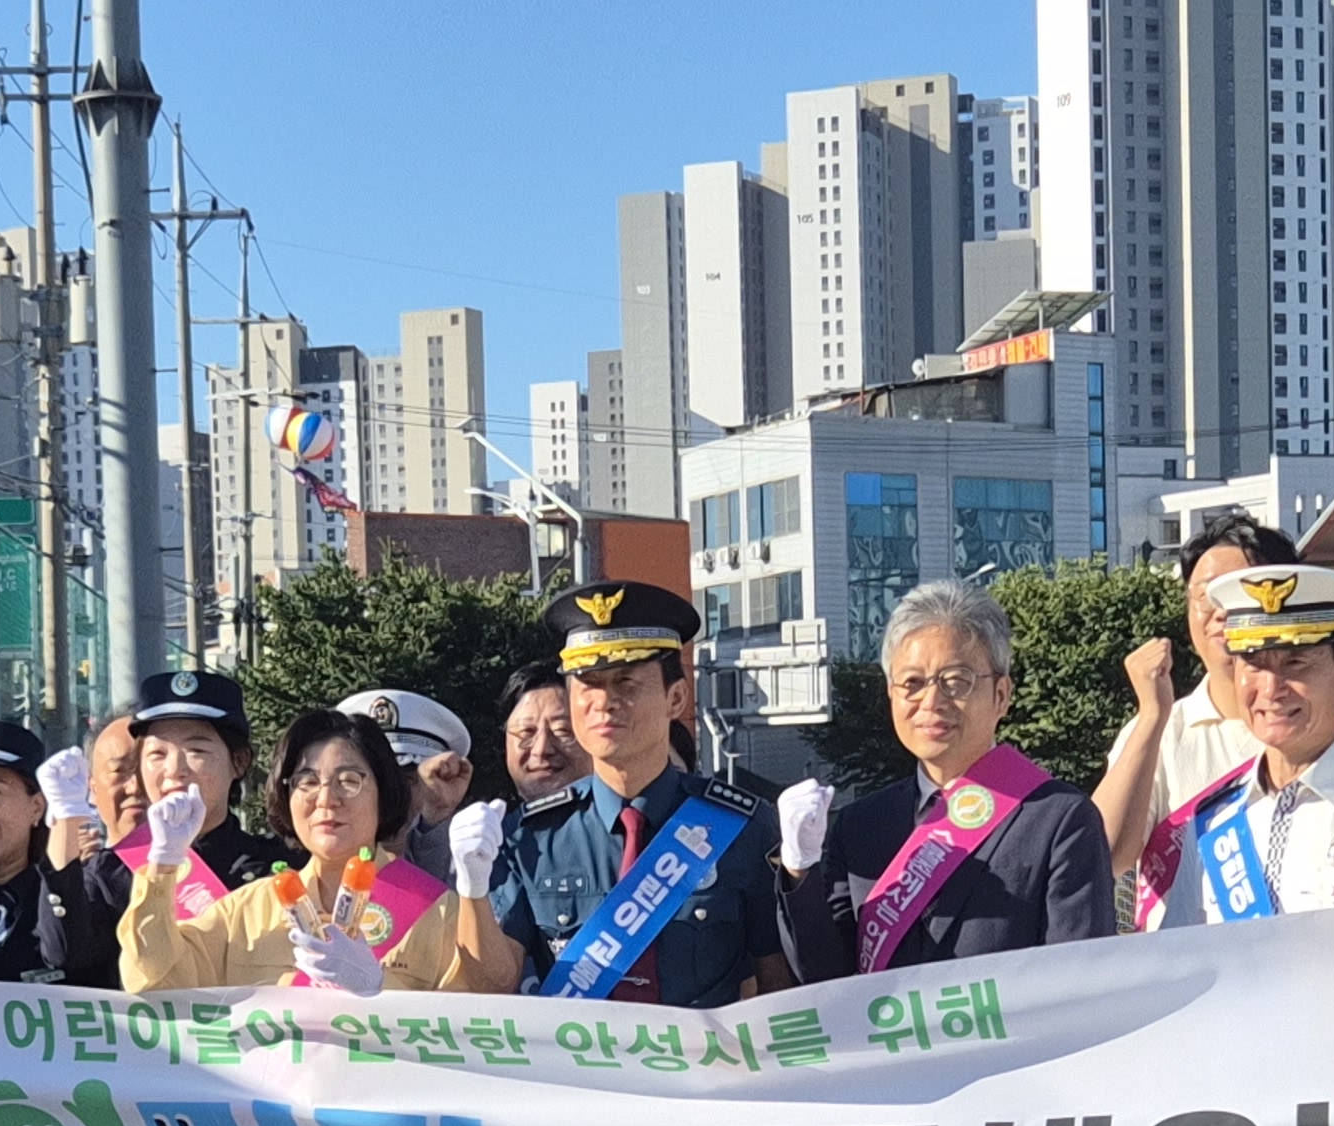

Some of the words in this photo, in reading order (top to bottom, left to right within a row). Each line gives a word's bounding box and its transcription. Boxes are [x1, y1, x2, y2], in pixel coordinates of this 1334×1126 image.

[1056, 91, 1071, 108] 109
[609, 849, 690, 938] 어린이
[1211, 826, 1255, 910] 어린이
[2, 998, 303, 1065] 어린이들이
[330, 1013, 532, 1066] 안전한
[555, 1007, 832, 1072] 안성시를
[866, 978, 1008, 1054] 위해
